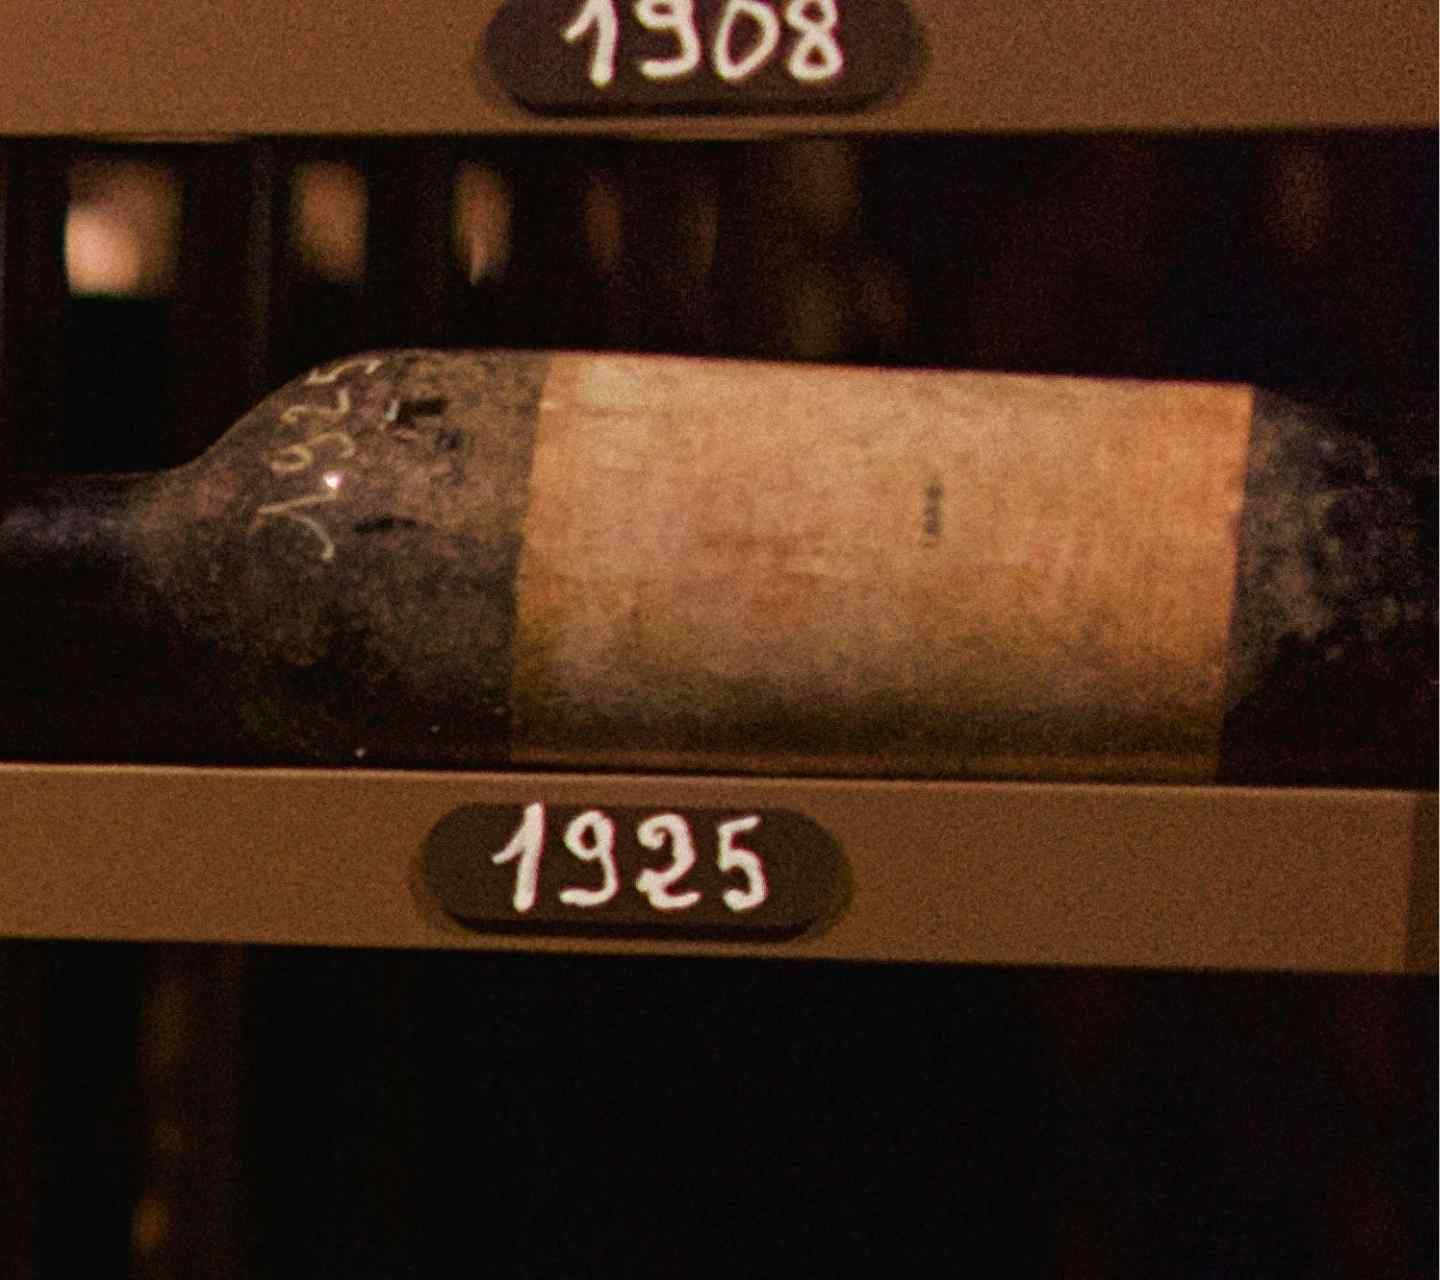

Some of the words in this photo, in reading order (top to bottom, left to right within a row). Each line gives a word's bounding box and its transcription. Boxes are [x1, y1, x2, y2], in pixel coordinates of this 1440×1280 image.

[561, 0, 845, 88] 1908
[256, 355, 385, 562] 1925
[489, 801, 768, 913] 1925
